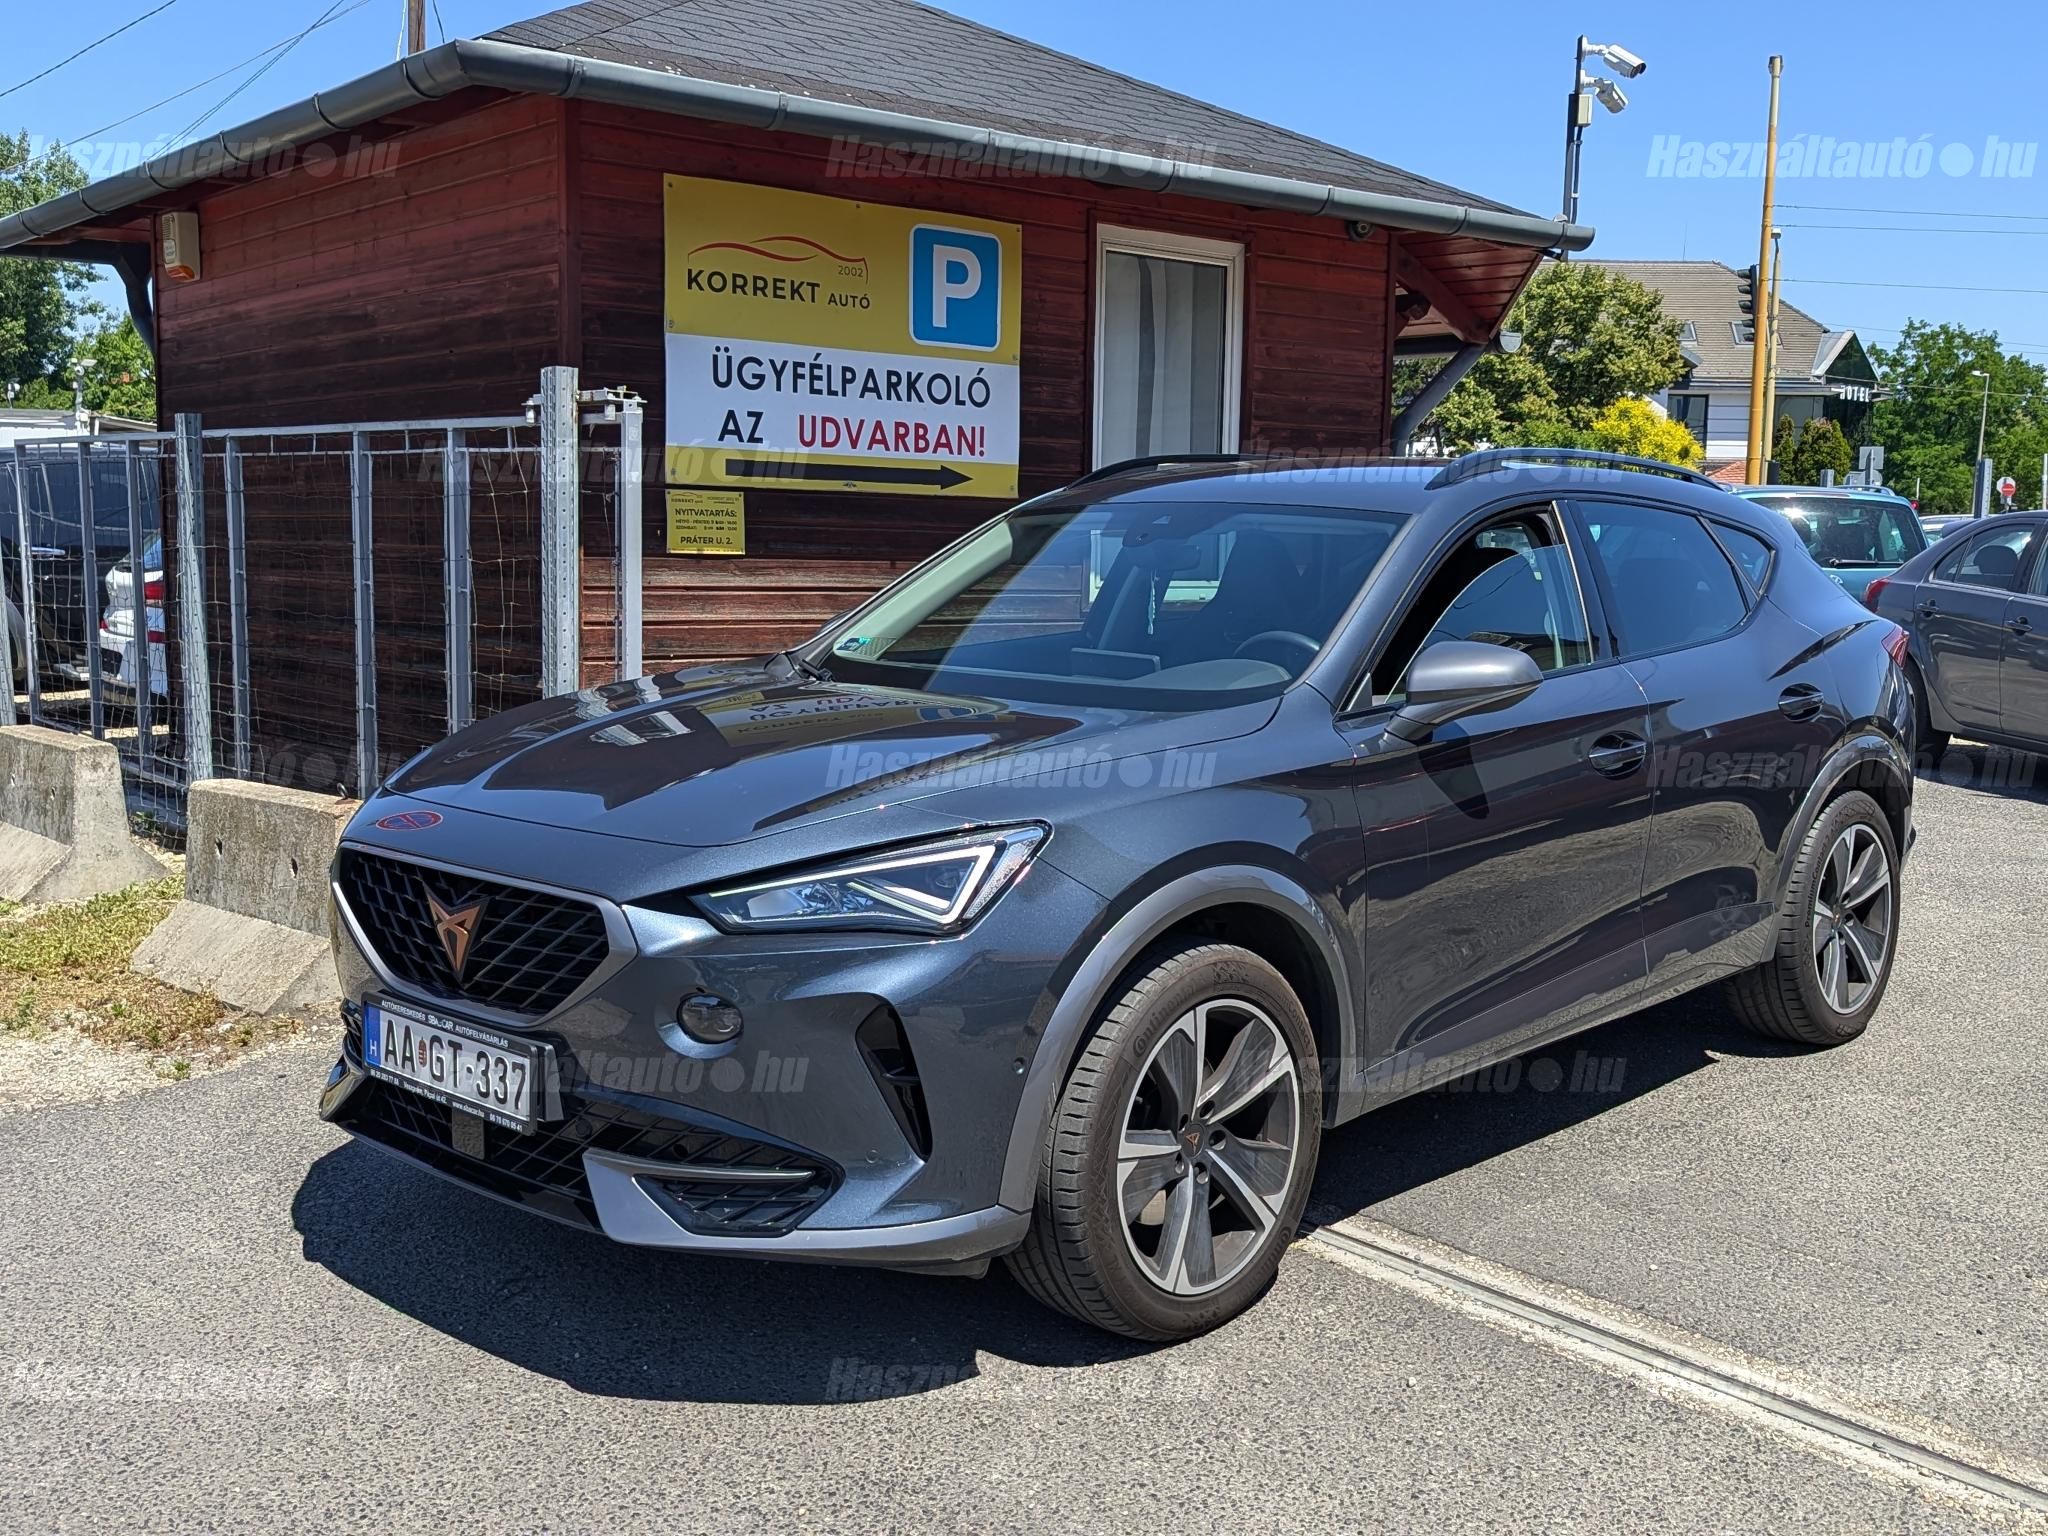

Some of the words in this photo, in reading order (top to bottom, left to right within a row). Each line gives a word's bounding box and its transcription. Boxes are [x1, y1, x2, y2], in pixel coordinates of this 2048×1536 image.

[687, 268, 821, 304] KORREKT
[827, 292, 871, 310] AUTÓ
[837, 265, 865, 279] 2002
[932, 244, 982, 329] P
[711, 345, 991, 409] ÜGYFÉLPARKOLÓ
[717, 409, 765, 444] AZ
[798, 414, 986, 458] UDVARBAN!
[675, 508, 737, 518] NYITVATARTÁS:
[680, 535, 714, 545] PRÁTER
[381, 1000, 426, 1021] AUTÓKERESKEDÉS
[455, 1025, 509, 1048] AUTÓFELVÁSÁRLÁS
[369, 1040, 377, 1056] H
[429, 1034, 527, 1110] GT-337
